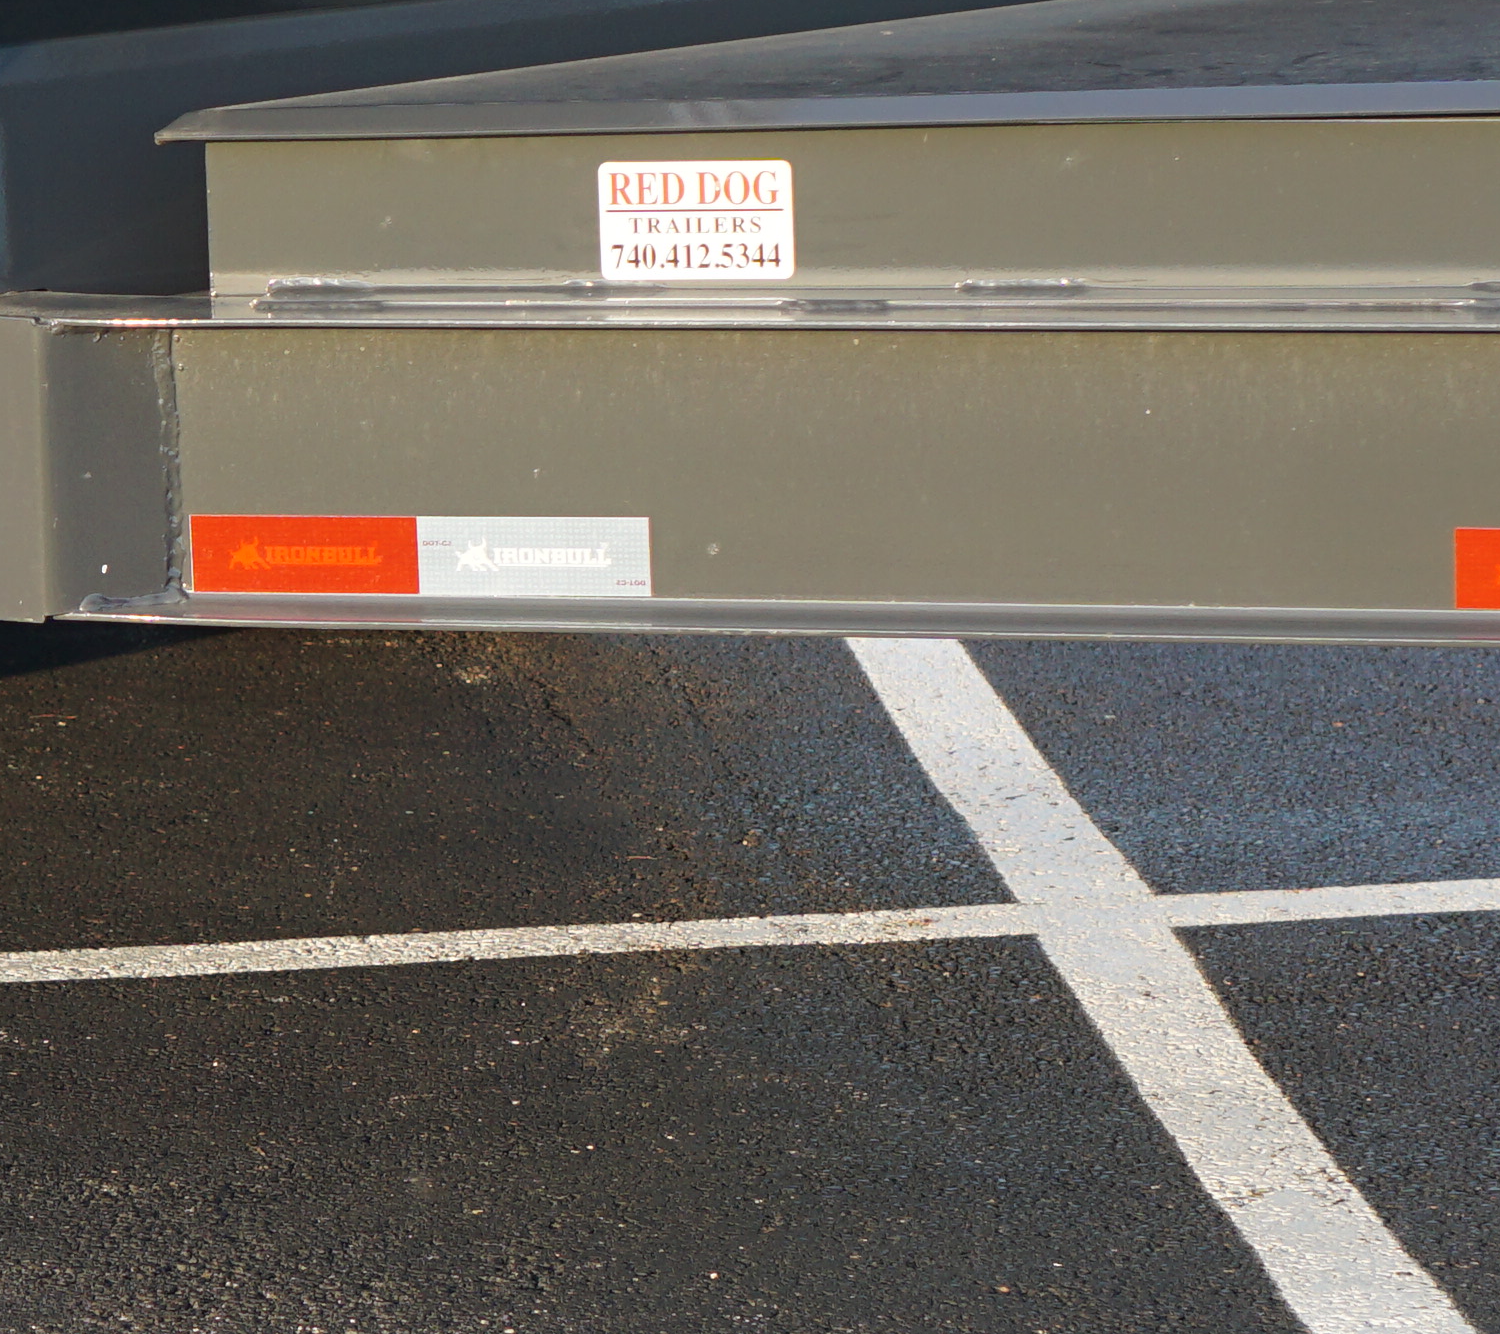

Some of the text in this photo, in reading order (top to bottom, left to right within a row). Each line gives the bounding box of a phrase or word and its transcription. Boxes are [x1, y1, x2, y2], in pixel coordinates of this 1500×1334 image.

[608, 170, 780, 206] RED DOG
[628, 215, 763, 234] TRAILERS
[611, 242, 782, 270] 740.412.5344
[263, 540, 384, 566] IRONBULL
[492, 541, 612, 567] IRONBULL
